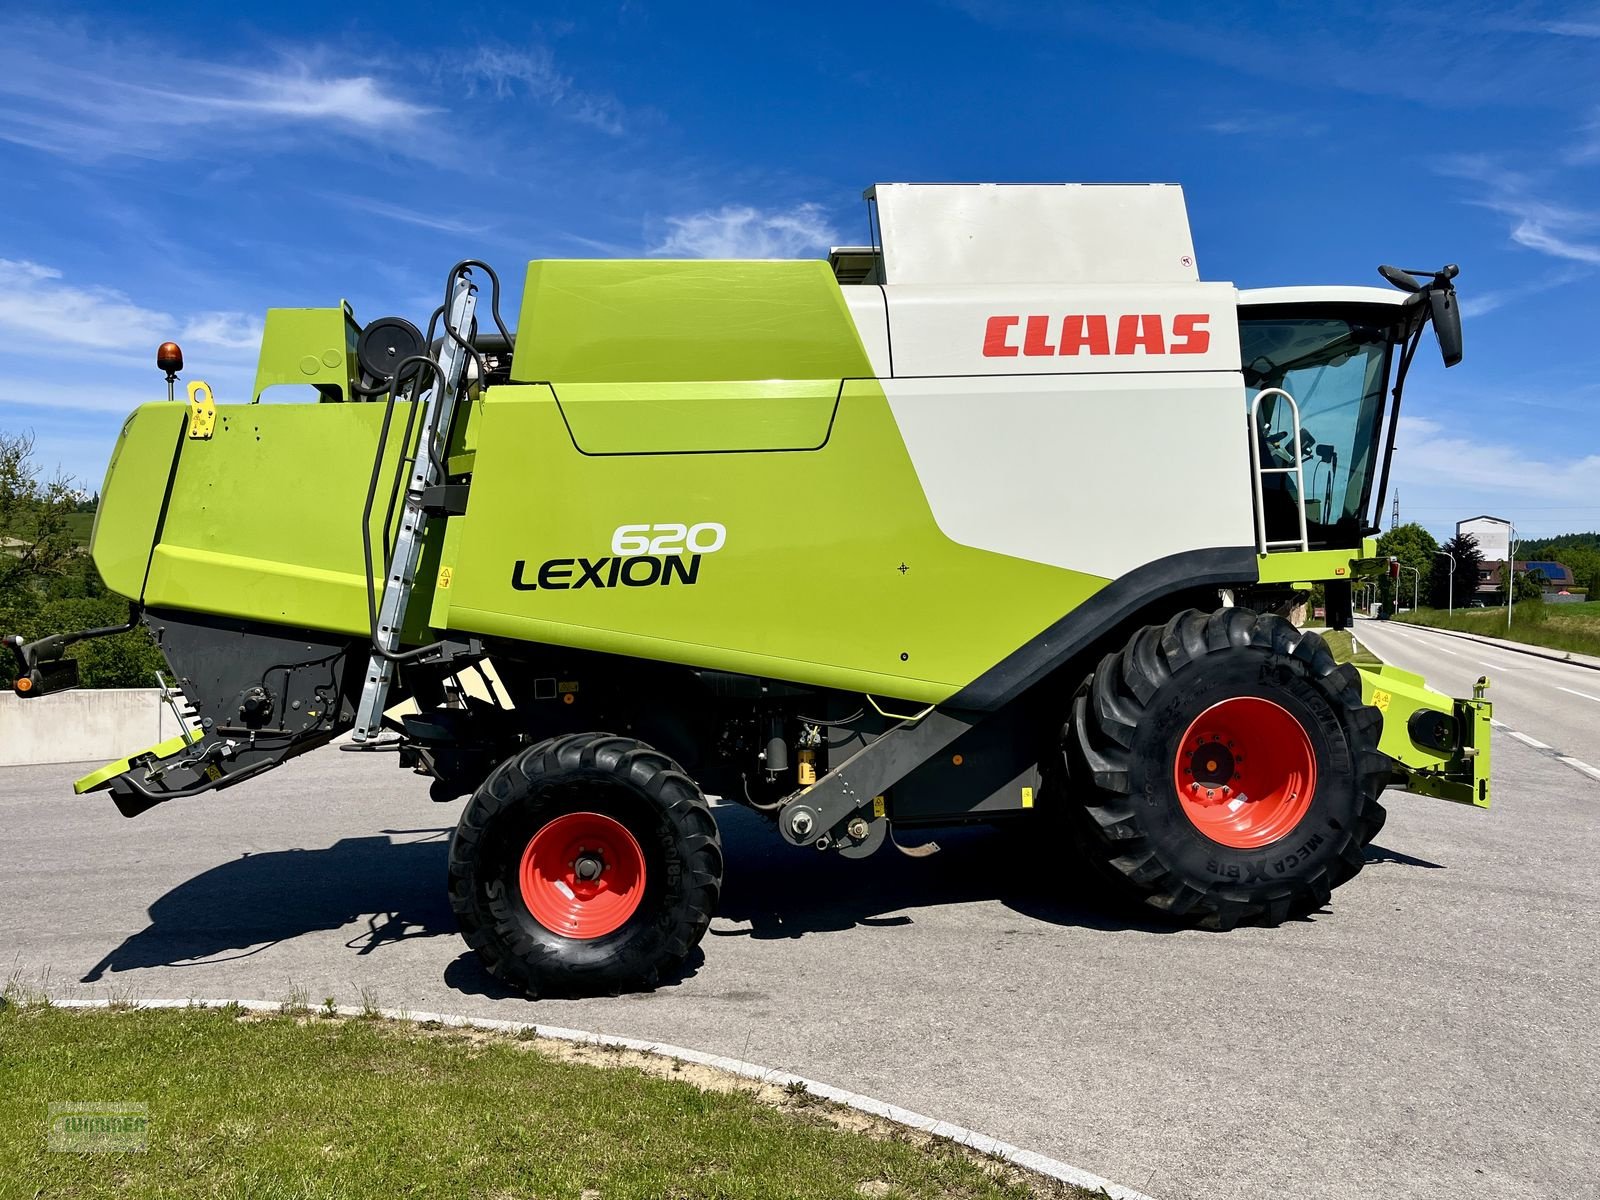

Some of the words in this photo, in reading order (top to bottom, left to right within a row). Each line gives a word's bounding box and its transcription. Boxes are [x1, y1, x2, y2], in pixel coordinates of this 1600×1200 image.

[982, 314, 1210, 357] CLAAS
[611, 522, 727, 556] 620
[511, 554, 702, 591] LEXION
